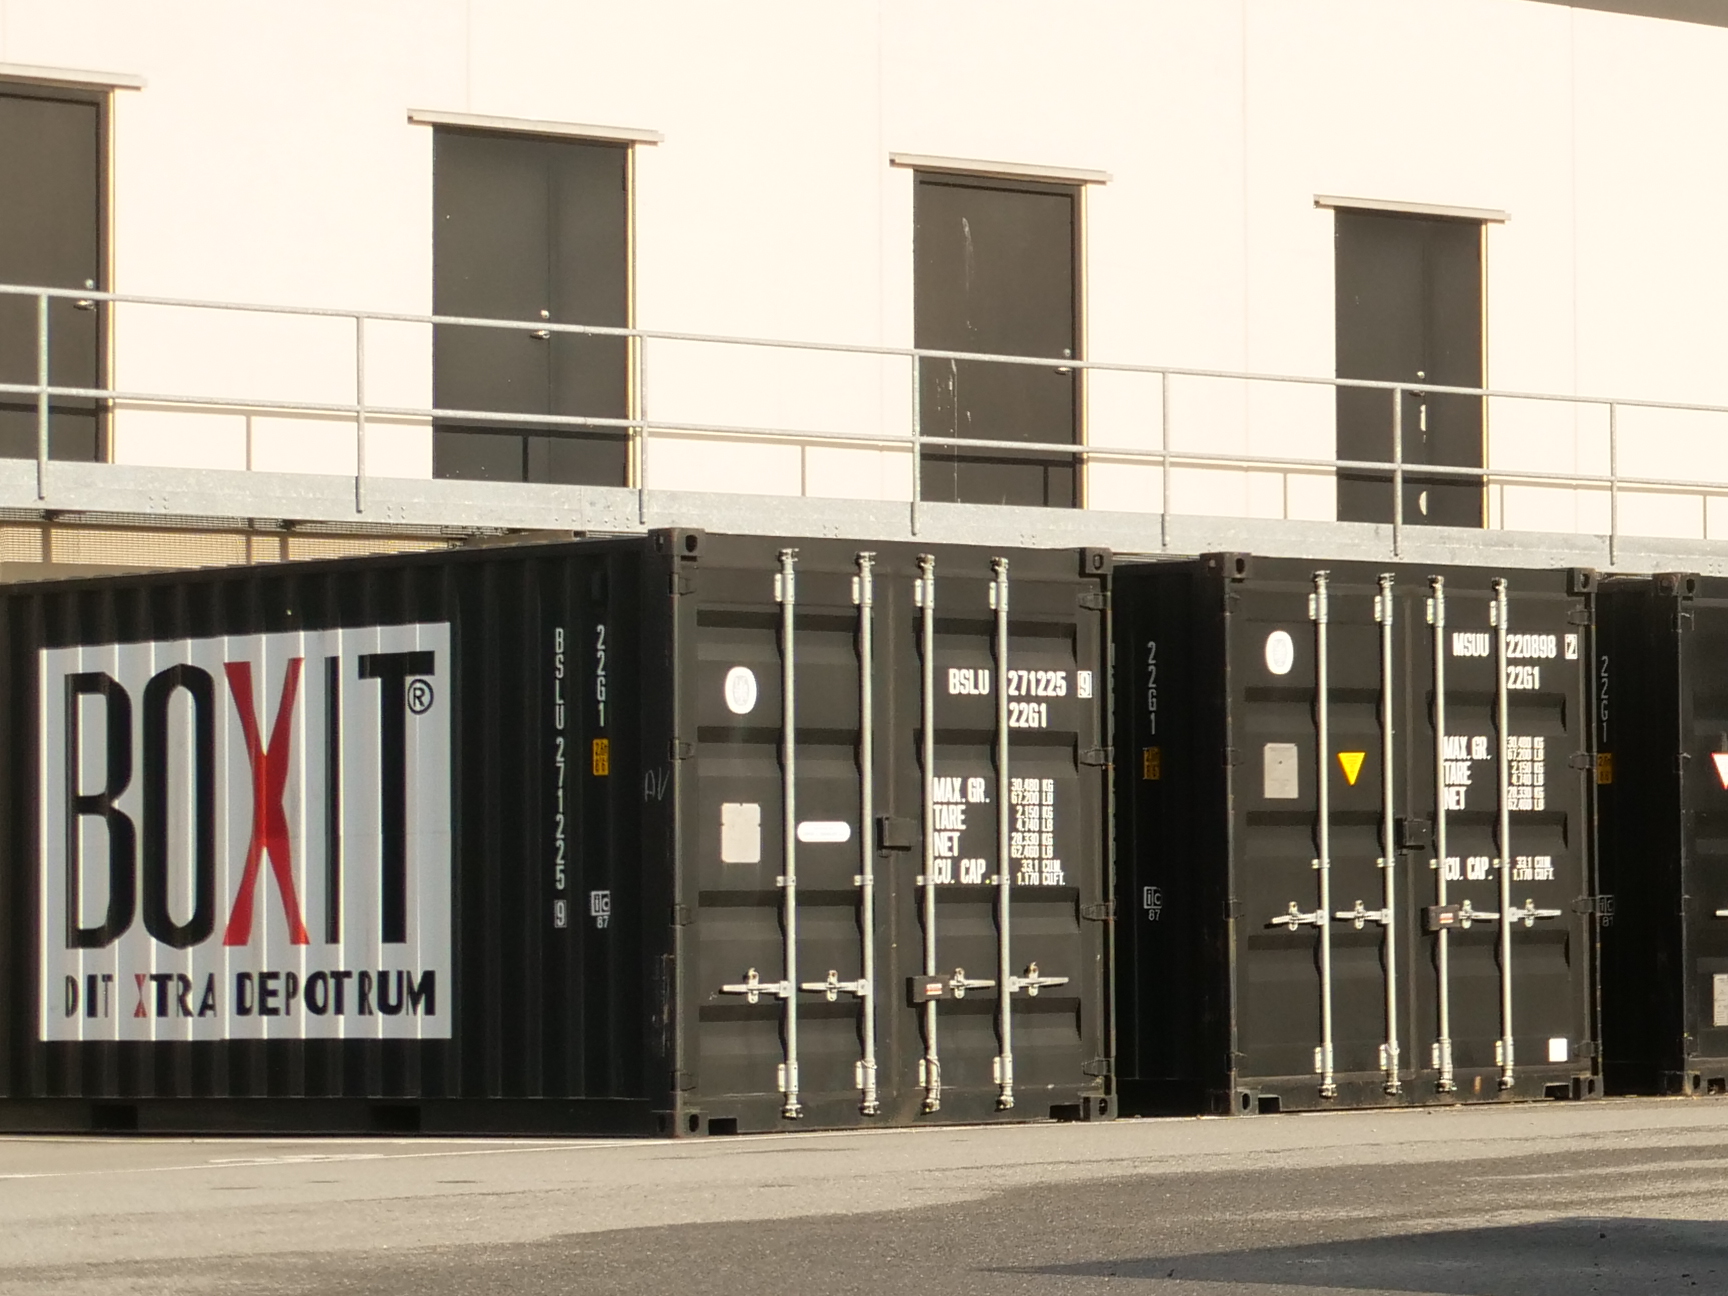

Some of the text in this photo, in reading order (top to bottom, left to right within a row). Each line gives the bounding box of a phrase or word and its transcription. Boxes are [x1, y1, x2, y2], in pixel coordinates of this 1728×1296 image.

[1453, 632, 1489, 657] MSUU
[1506, 634, 1557, 658] 220898
[555, 628, 564, 729] BSLU
[597, 625, 605, 726] 22G1
[948, 668, 990, 695] BSLU
[1008, 670, 1067, 696] 271225
[1147, 641, 1156, 735] 22G1
[1507, 666, 1540, 689] 22G1
[1009, 702, 1047, 728] 22G1
[1042, 779, 1054, 791] KG
[1443, 761, 1472, 785] TARE
[65, 651, 435, 949] BOXIT
[933, 777, 990, 803] MAX. GR.
[1042, 791, 1054, 805] LB
[1443, 786, 1467, 810] NET
[555, 737, 565, 889] 271225
[933, 804, 966, 830] TARE
[1042, 805, 1054, 818] KG
[1042, 818, 1053, 831] LB
[934, 831, 960, 857] NET
[1042, 832, 1053, 845] KG
[1042, 846, 1053, 858] LB
[934, 859, 991, 884] CU. CAP.
[65, 970, 436, 1018] DIT XTRA DEPOTRUM
